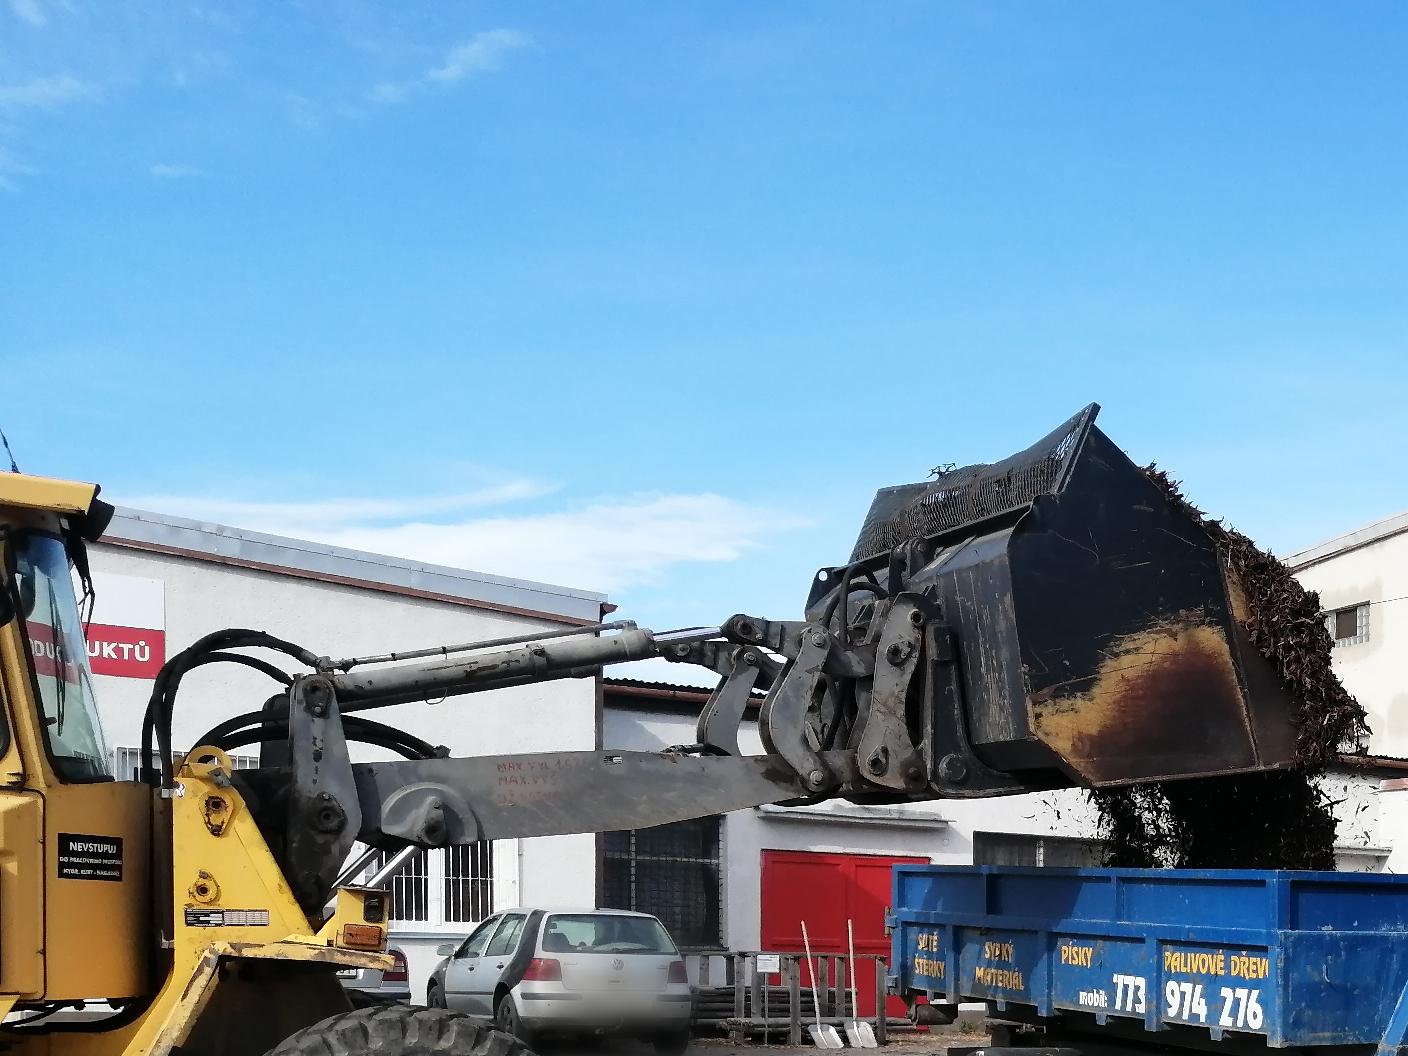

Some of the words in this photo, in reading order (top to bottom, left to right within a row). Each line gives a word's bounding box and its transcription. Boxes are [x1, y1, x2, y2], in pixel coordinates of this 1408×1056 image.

[1061, 941, 1093, 969] PÍSKY
[1164, 949, 1225, 976] PALIVOVÉ
[975, 966, 1025, 991] MATERIÁL
[1112, 973, 1146, 1014] 773
[1165, 980, 1208, 1023] 974
[1219, 986, 1264, 1030] 276
